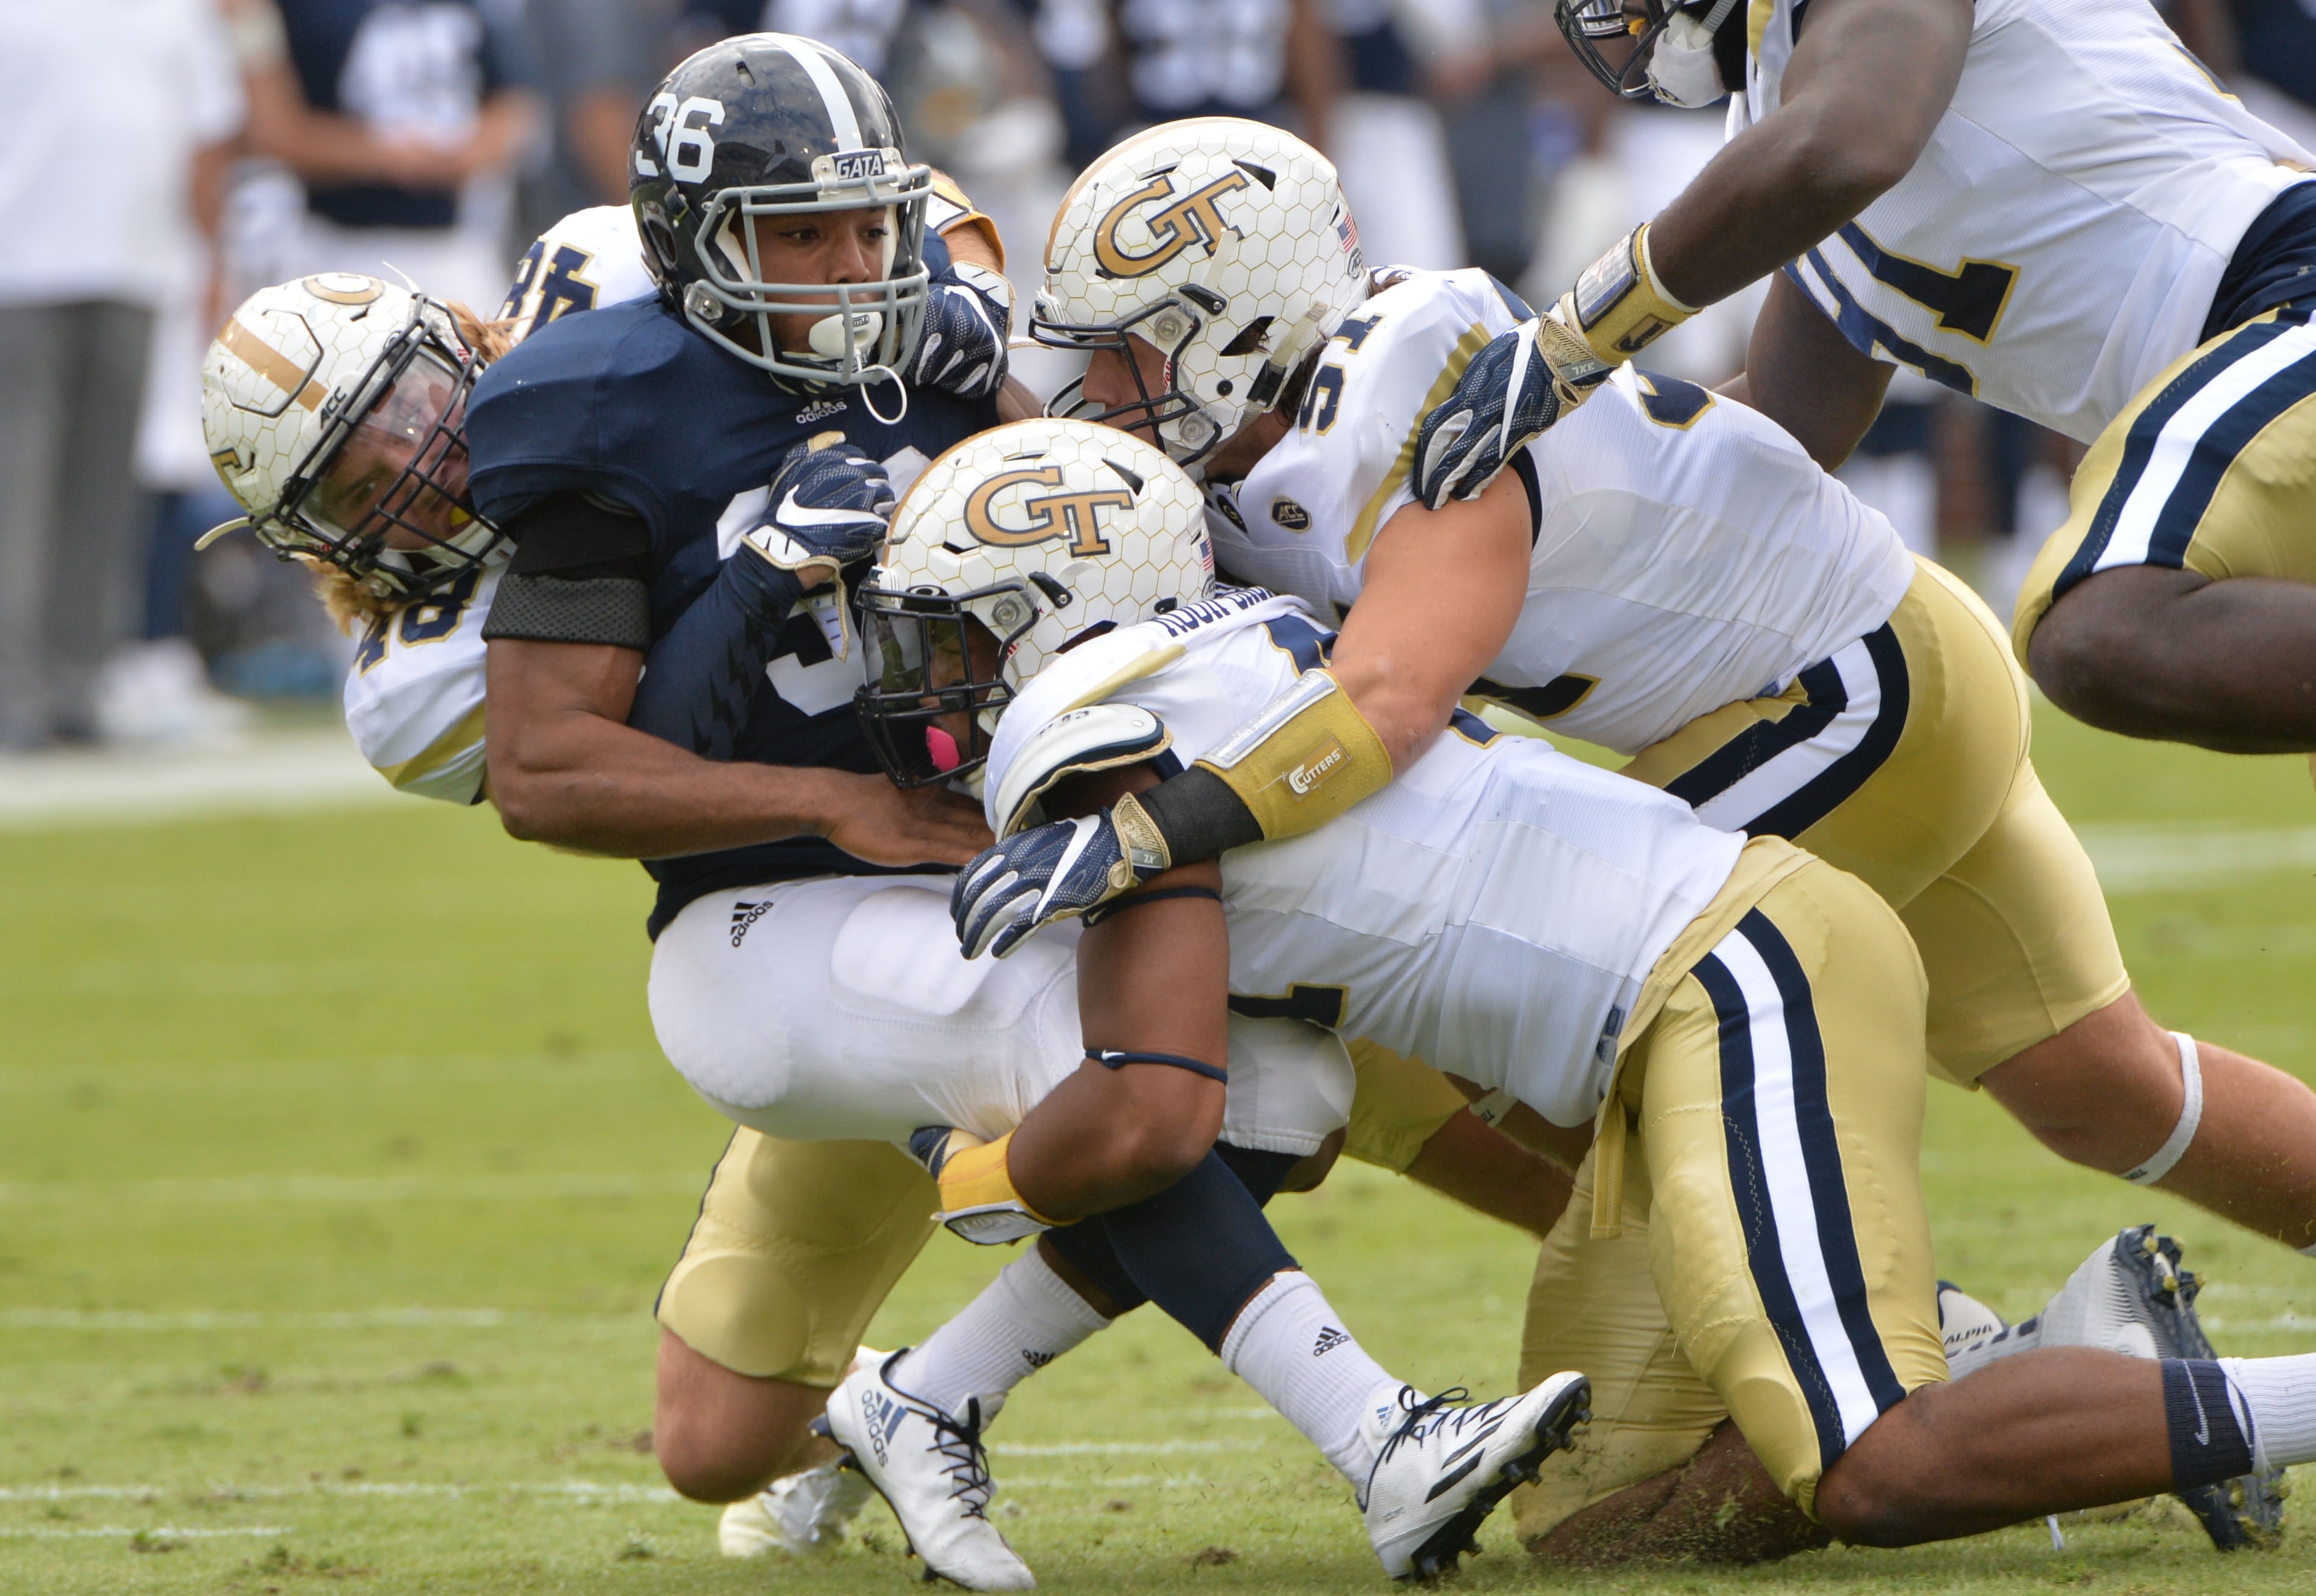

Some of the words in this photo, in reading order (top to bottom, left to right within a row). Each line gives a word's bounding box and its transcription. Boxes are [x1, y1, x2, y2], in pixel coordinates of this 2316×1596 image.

[634, 92, 726, 184] 36
[837, 154, 883, 179] GATA
[1093, 169, 1250, 279] GT
[1300, 313, 1387, 437] 51
[1572, 362, 1595, 376] 3XL
[320, 385, 347, 430] ACC
[796, 402, 847, 424] adidas
[964, 466, 1134, 557] GT
[1277, 504, 1305, 522] ACC
[1289, 748, 1341, 794] CUTTERS
[1144, 854, 1157, 864] XL
[732, 901, 774, 947] adidas
[1313, 1334, 1352, 1357] adidas
[861, 1390, 888, 1468] adidas
